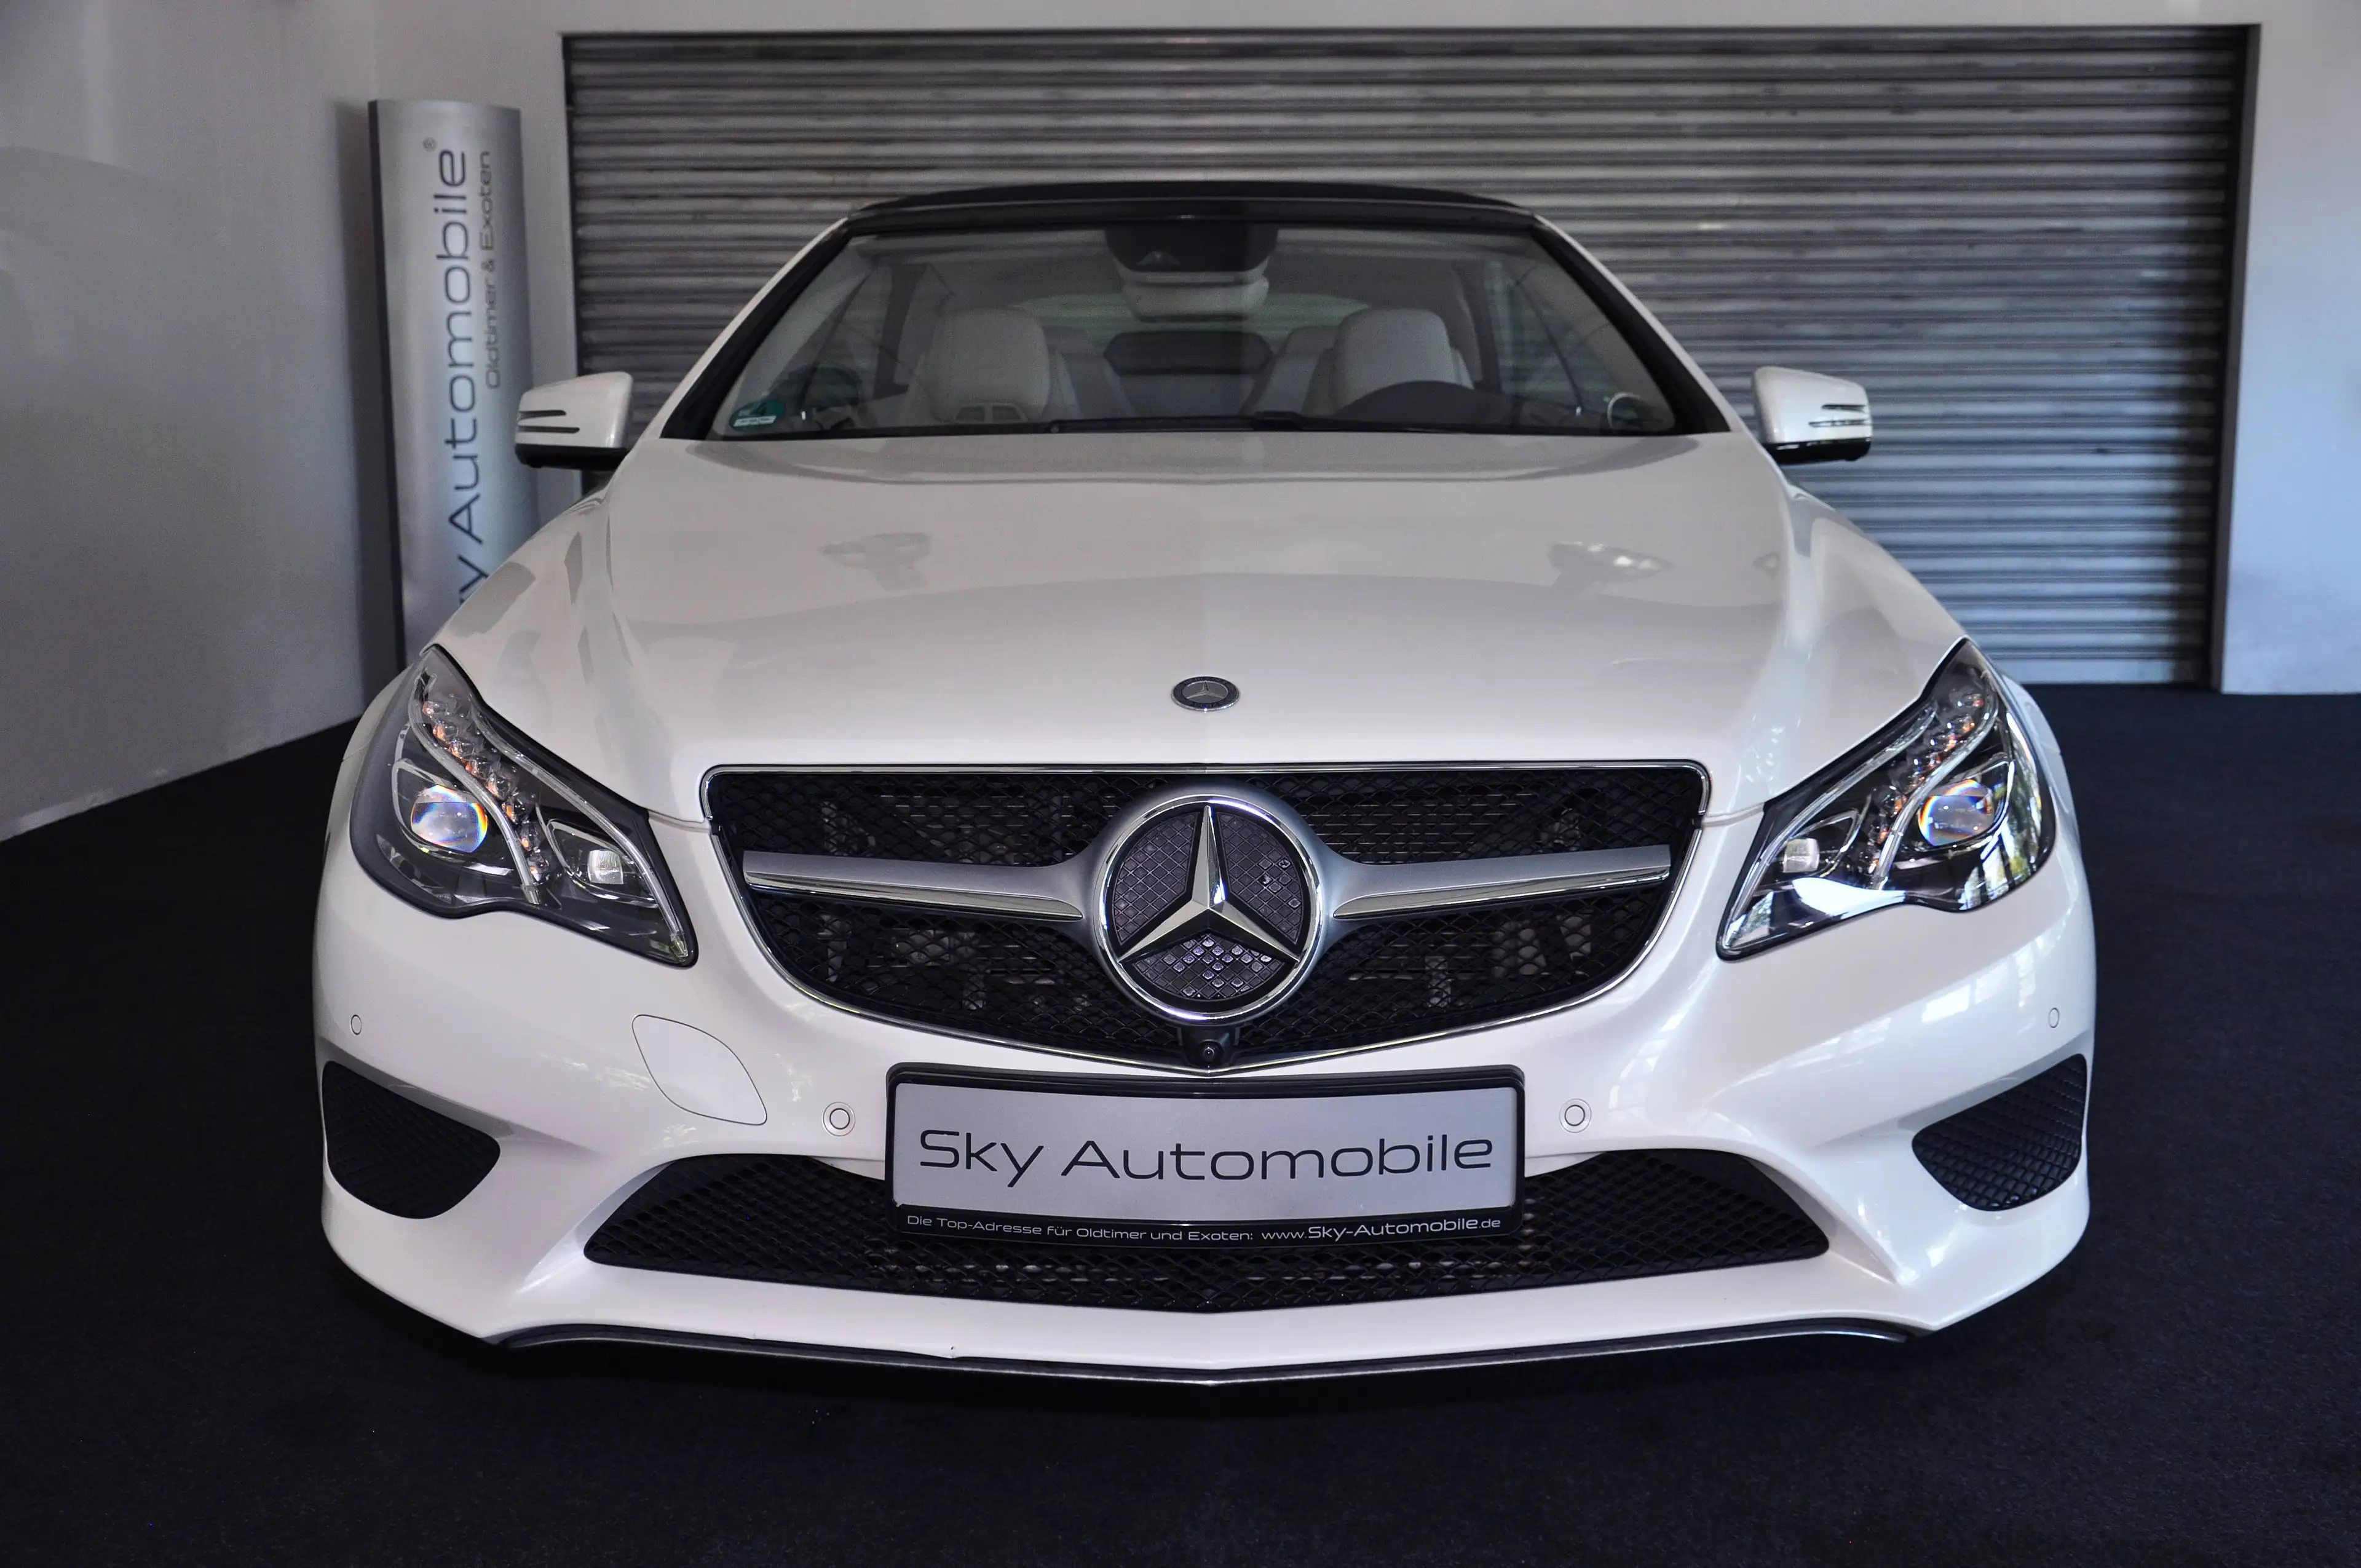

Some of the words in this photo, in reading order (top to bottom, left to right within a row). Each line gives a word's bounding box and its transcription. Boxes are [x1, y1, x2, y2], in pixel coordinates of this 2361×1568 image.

[479, 151, 494, 251] Exoten
[480, 258, 496, 272] &
[485, 277, 501, 390] Oldtimer
[919, 1128, 1045, 1189] Sky
[1060, 1133, 1493, 1181] Automobile
[907, 1215, 933, 1227] Die
[936, 1217, 1042, 1235] Top-Adresse
[1046, 1225, 1072, 1237] für
[1076, 1227, 1147, 1240] Oldtimer
[1150, 1230, 1183, 1241] und
[1188, 1231, 1254, 1241] Exoten:
[1261, 1218, 1501, 1242] www.Sky-Automobile.de
